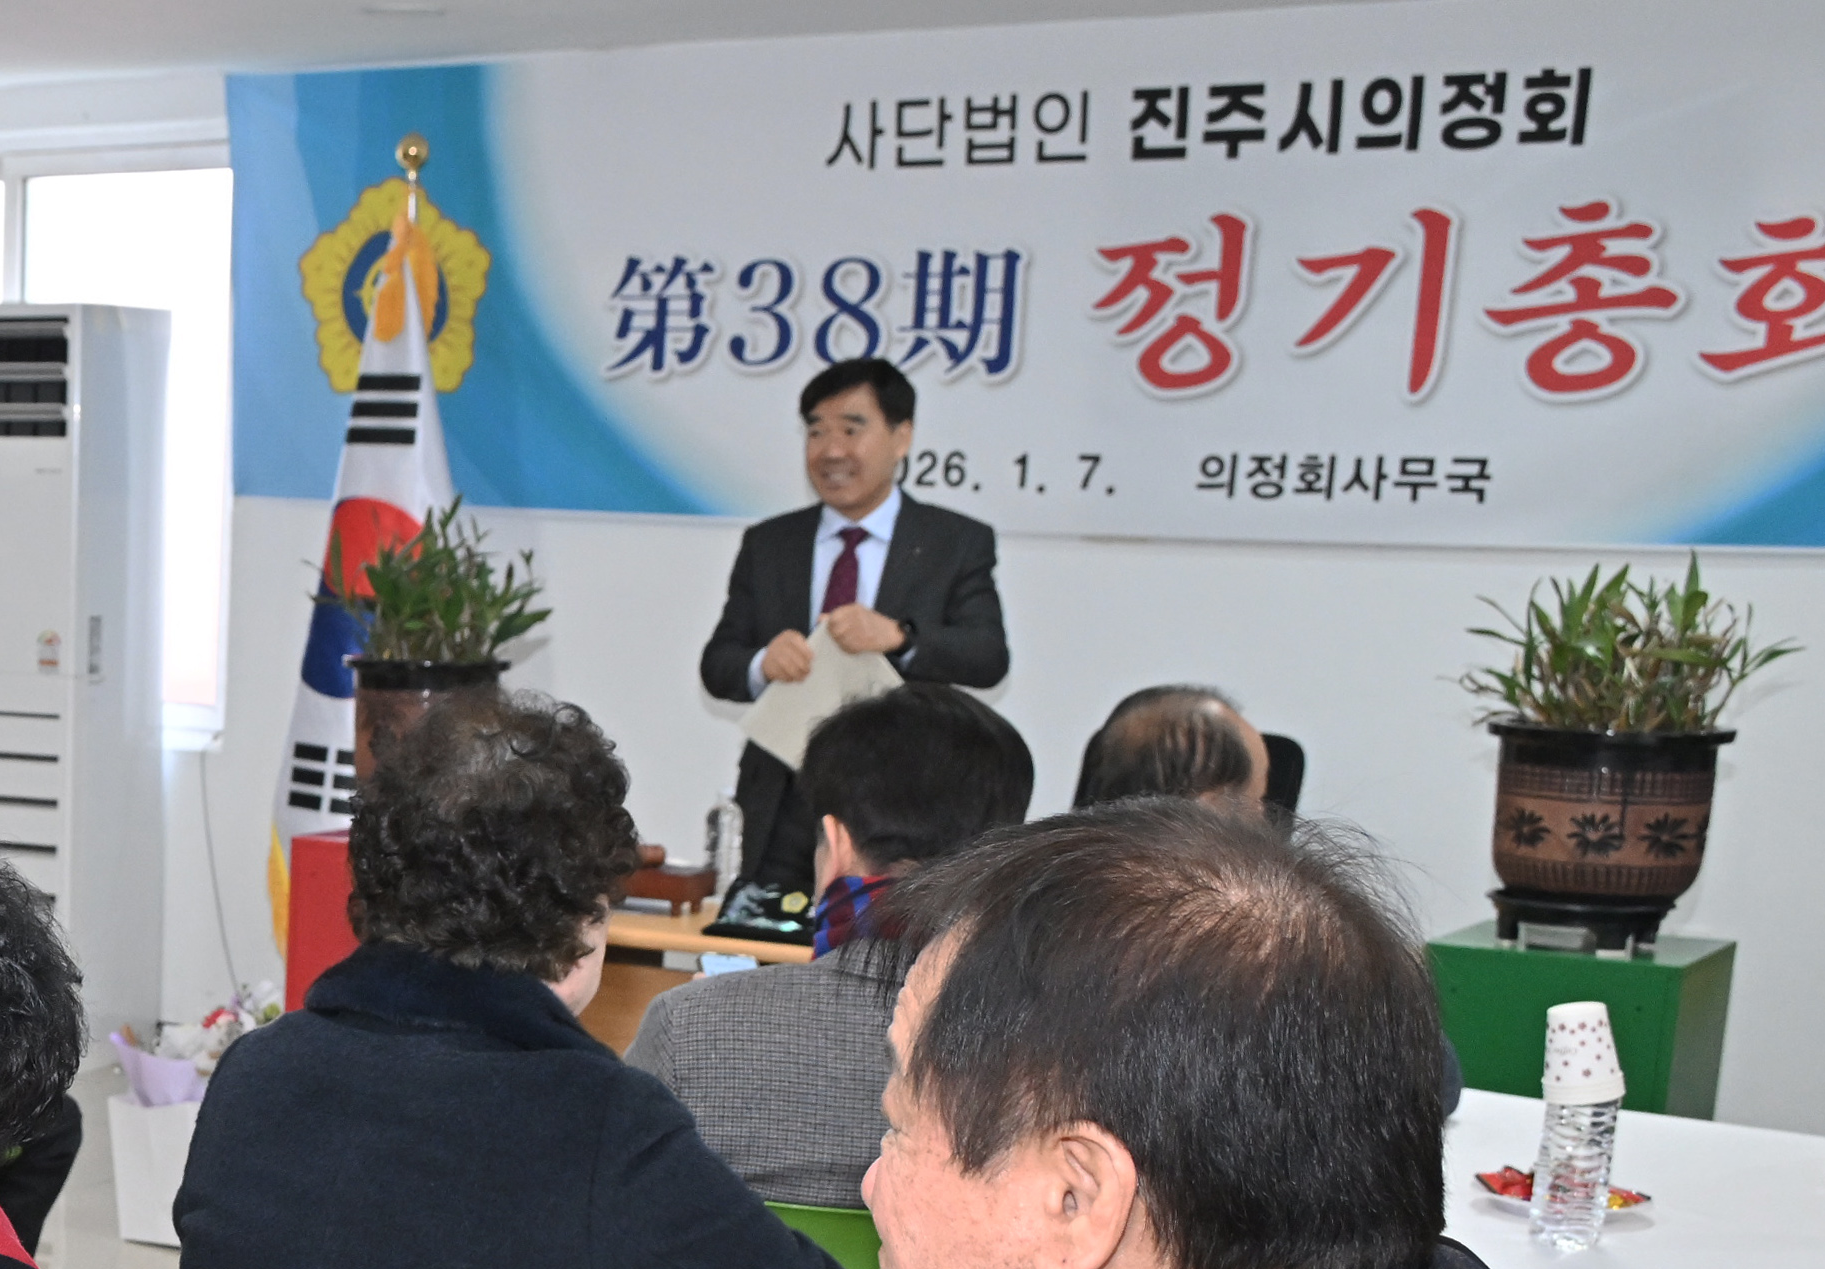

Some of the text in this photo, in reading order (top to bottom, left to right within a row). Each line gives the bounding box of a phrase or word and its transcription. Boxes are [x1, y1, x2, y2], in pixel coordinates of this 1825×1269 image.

[826, 67, 1593, 169] 사단법인 진주시의정회
[606, 249, 1022, 373] 第38期
[1013, 452, 1046, 494] 1.
[1078, 454, 1116, 495] 7.
[1196, 451, 1492, 503] 의정회사무국
